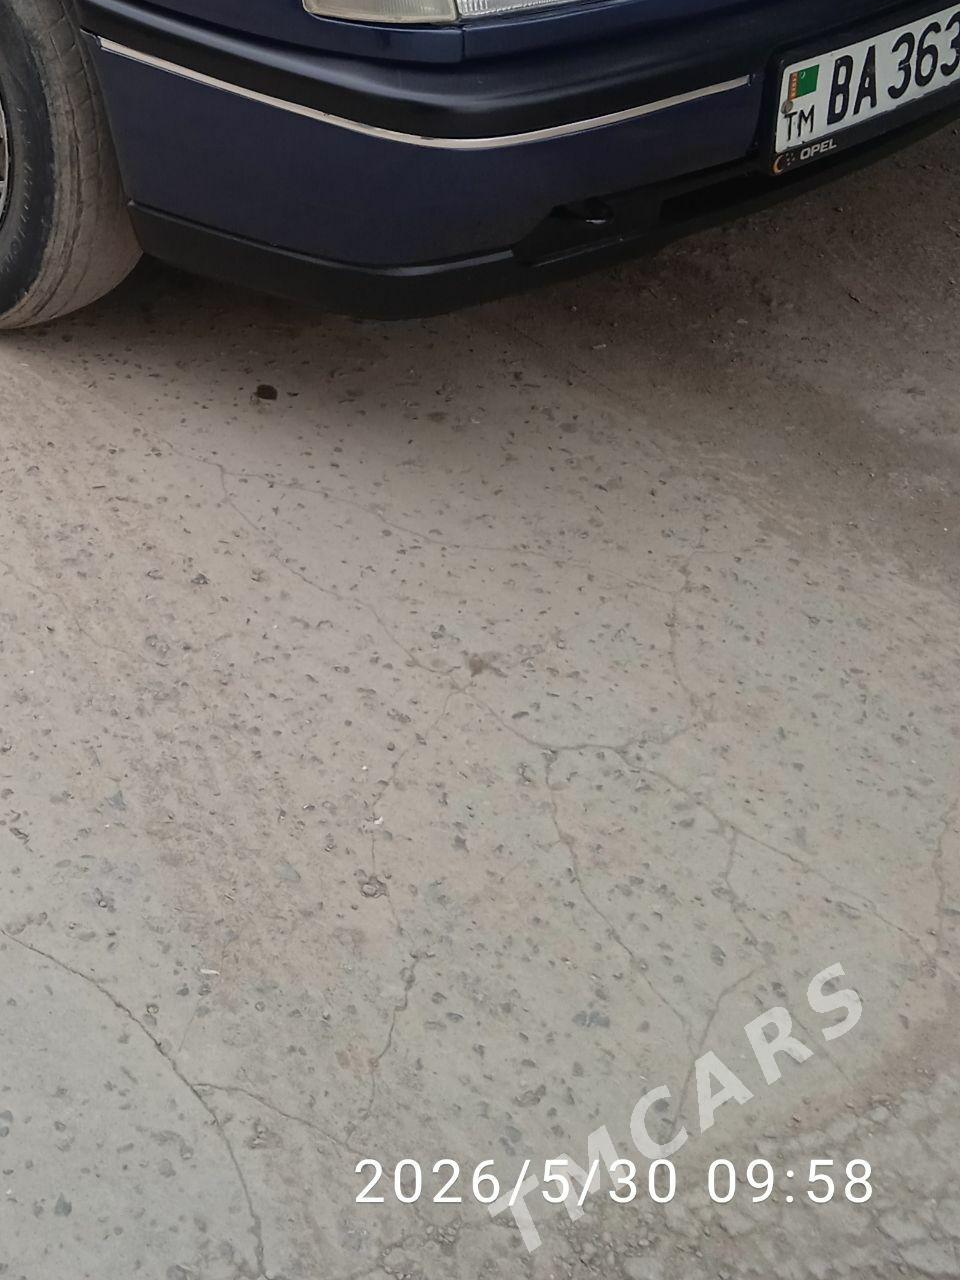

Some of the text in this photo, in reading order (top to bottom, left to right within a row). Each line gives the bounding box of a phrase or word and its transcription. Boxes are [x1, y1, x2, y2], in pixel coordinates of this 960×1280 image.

[826, 10, 960, 126] BA 363
[783, 104, 815, 141] TM
[799, 138, 838, 161] OPEL
